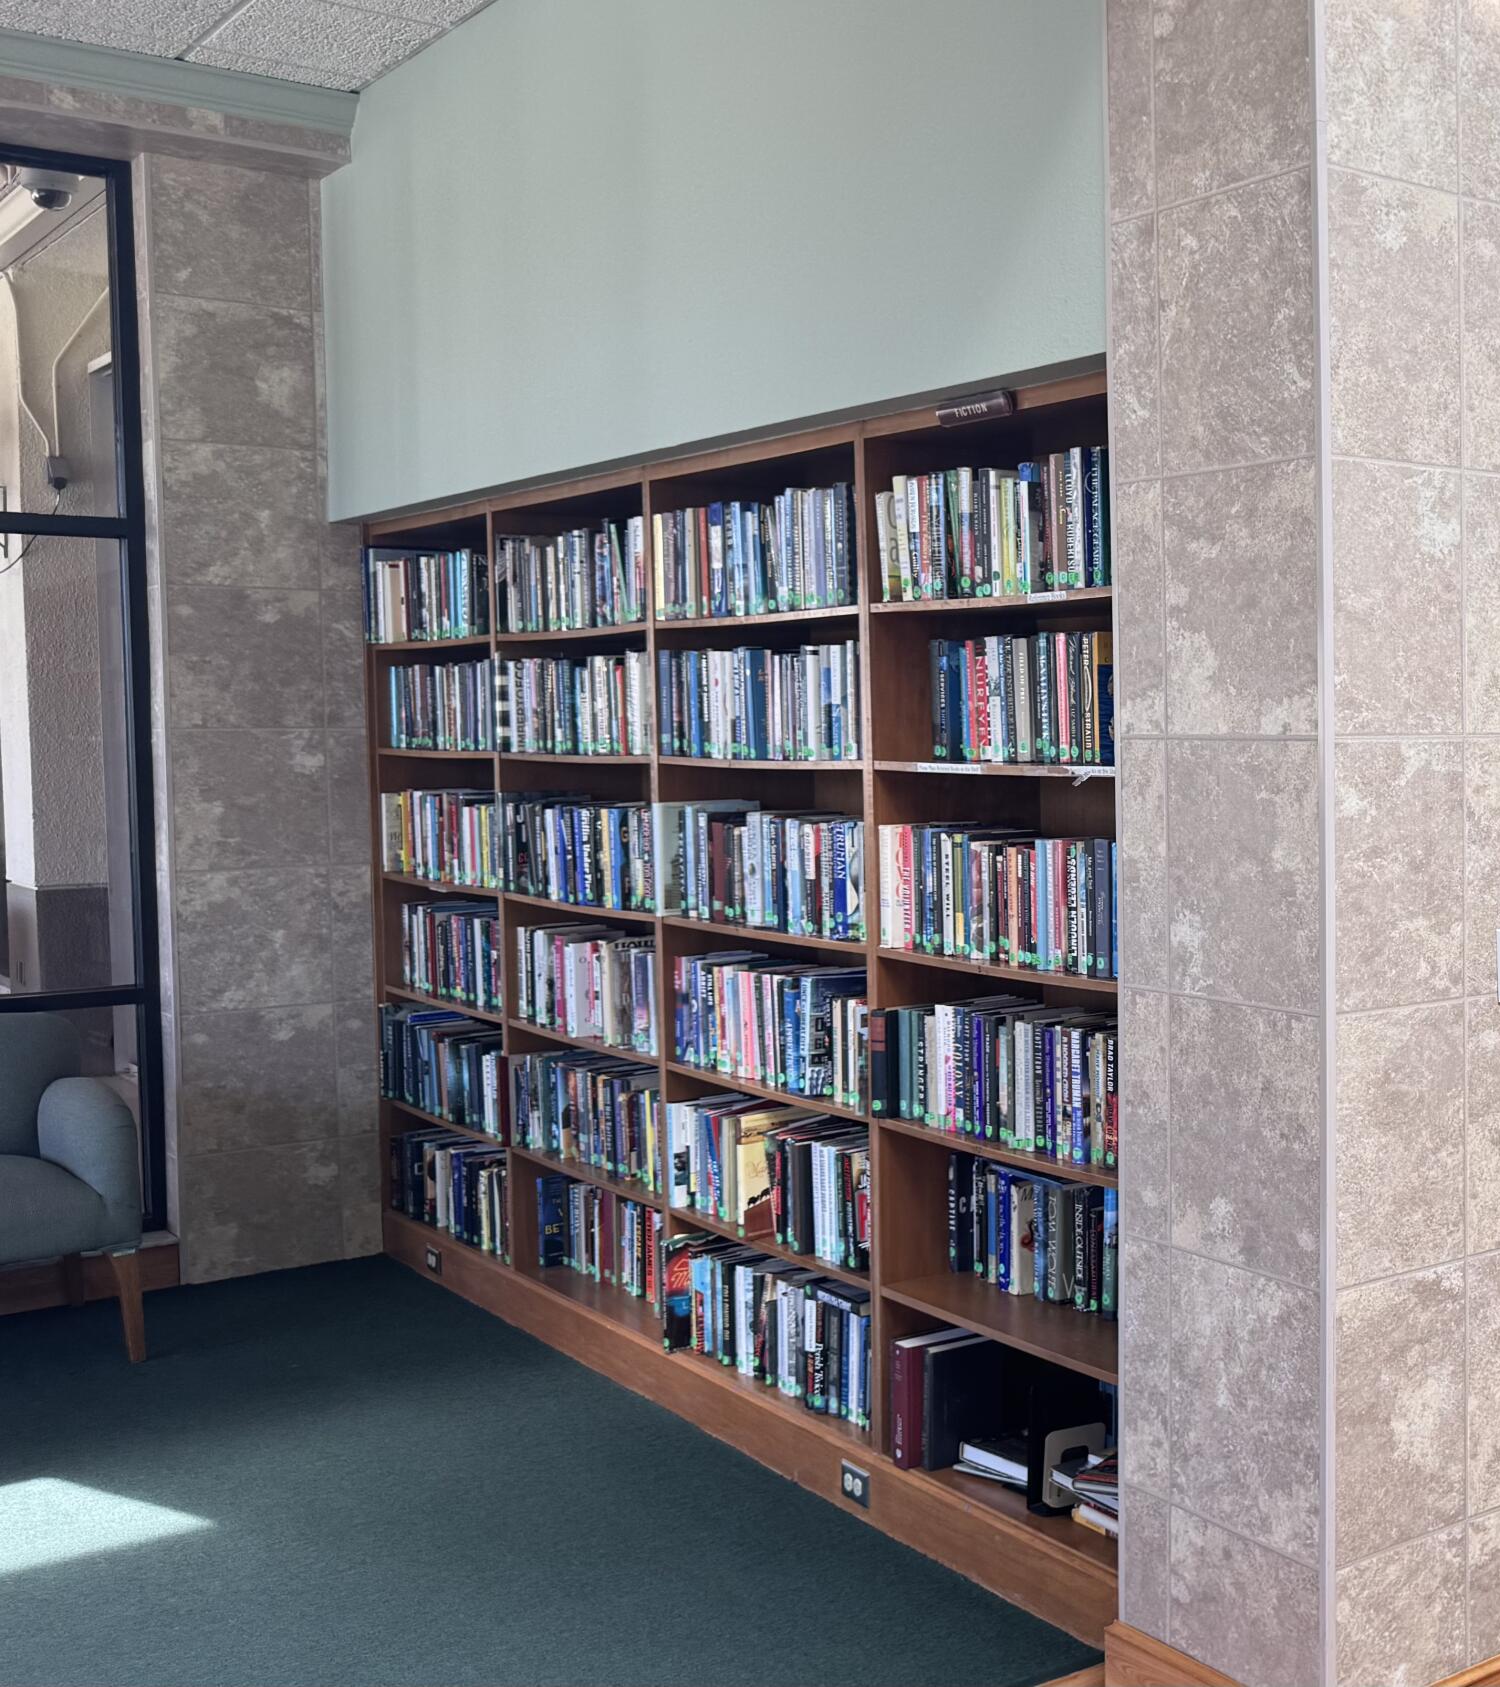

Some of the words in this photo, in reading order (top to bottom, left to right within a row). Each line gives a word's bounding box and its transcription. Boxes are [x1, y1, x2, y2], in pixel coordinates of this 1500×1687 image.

[953, 402, 988, 417] FICTION
[1085, 713, 1093, 748] STRAUB
[582, 810, 590, 841] Griffin
[583, 845, 591, 873] Under
[836, 829, 845, 879] TRUMAN
[1071, 1031, 1080, 1072] MARGARET
[953, 1043, 963, 1098] COLONY
[1072, 1075, 1081, 1108] TRUMAN
[1048, 1196, 1057, 1232] TOM
[1048, 1240, 1057, 1289] WOLFE
[1075, 1237, 1083, 1280] OUTSIDE
[814, 1343, 824, 1370] Perish
